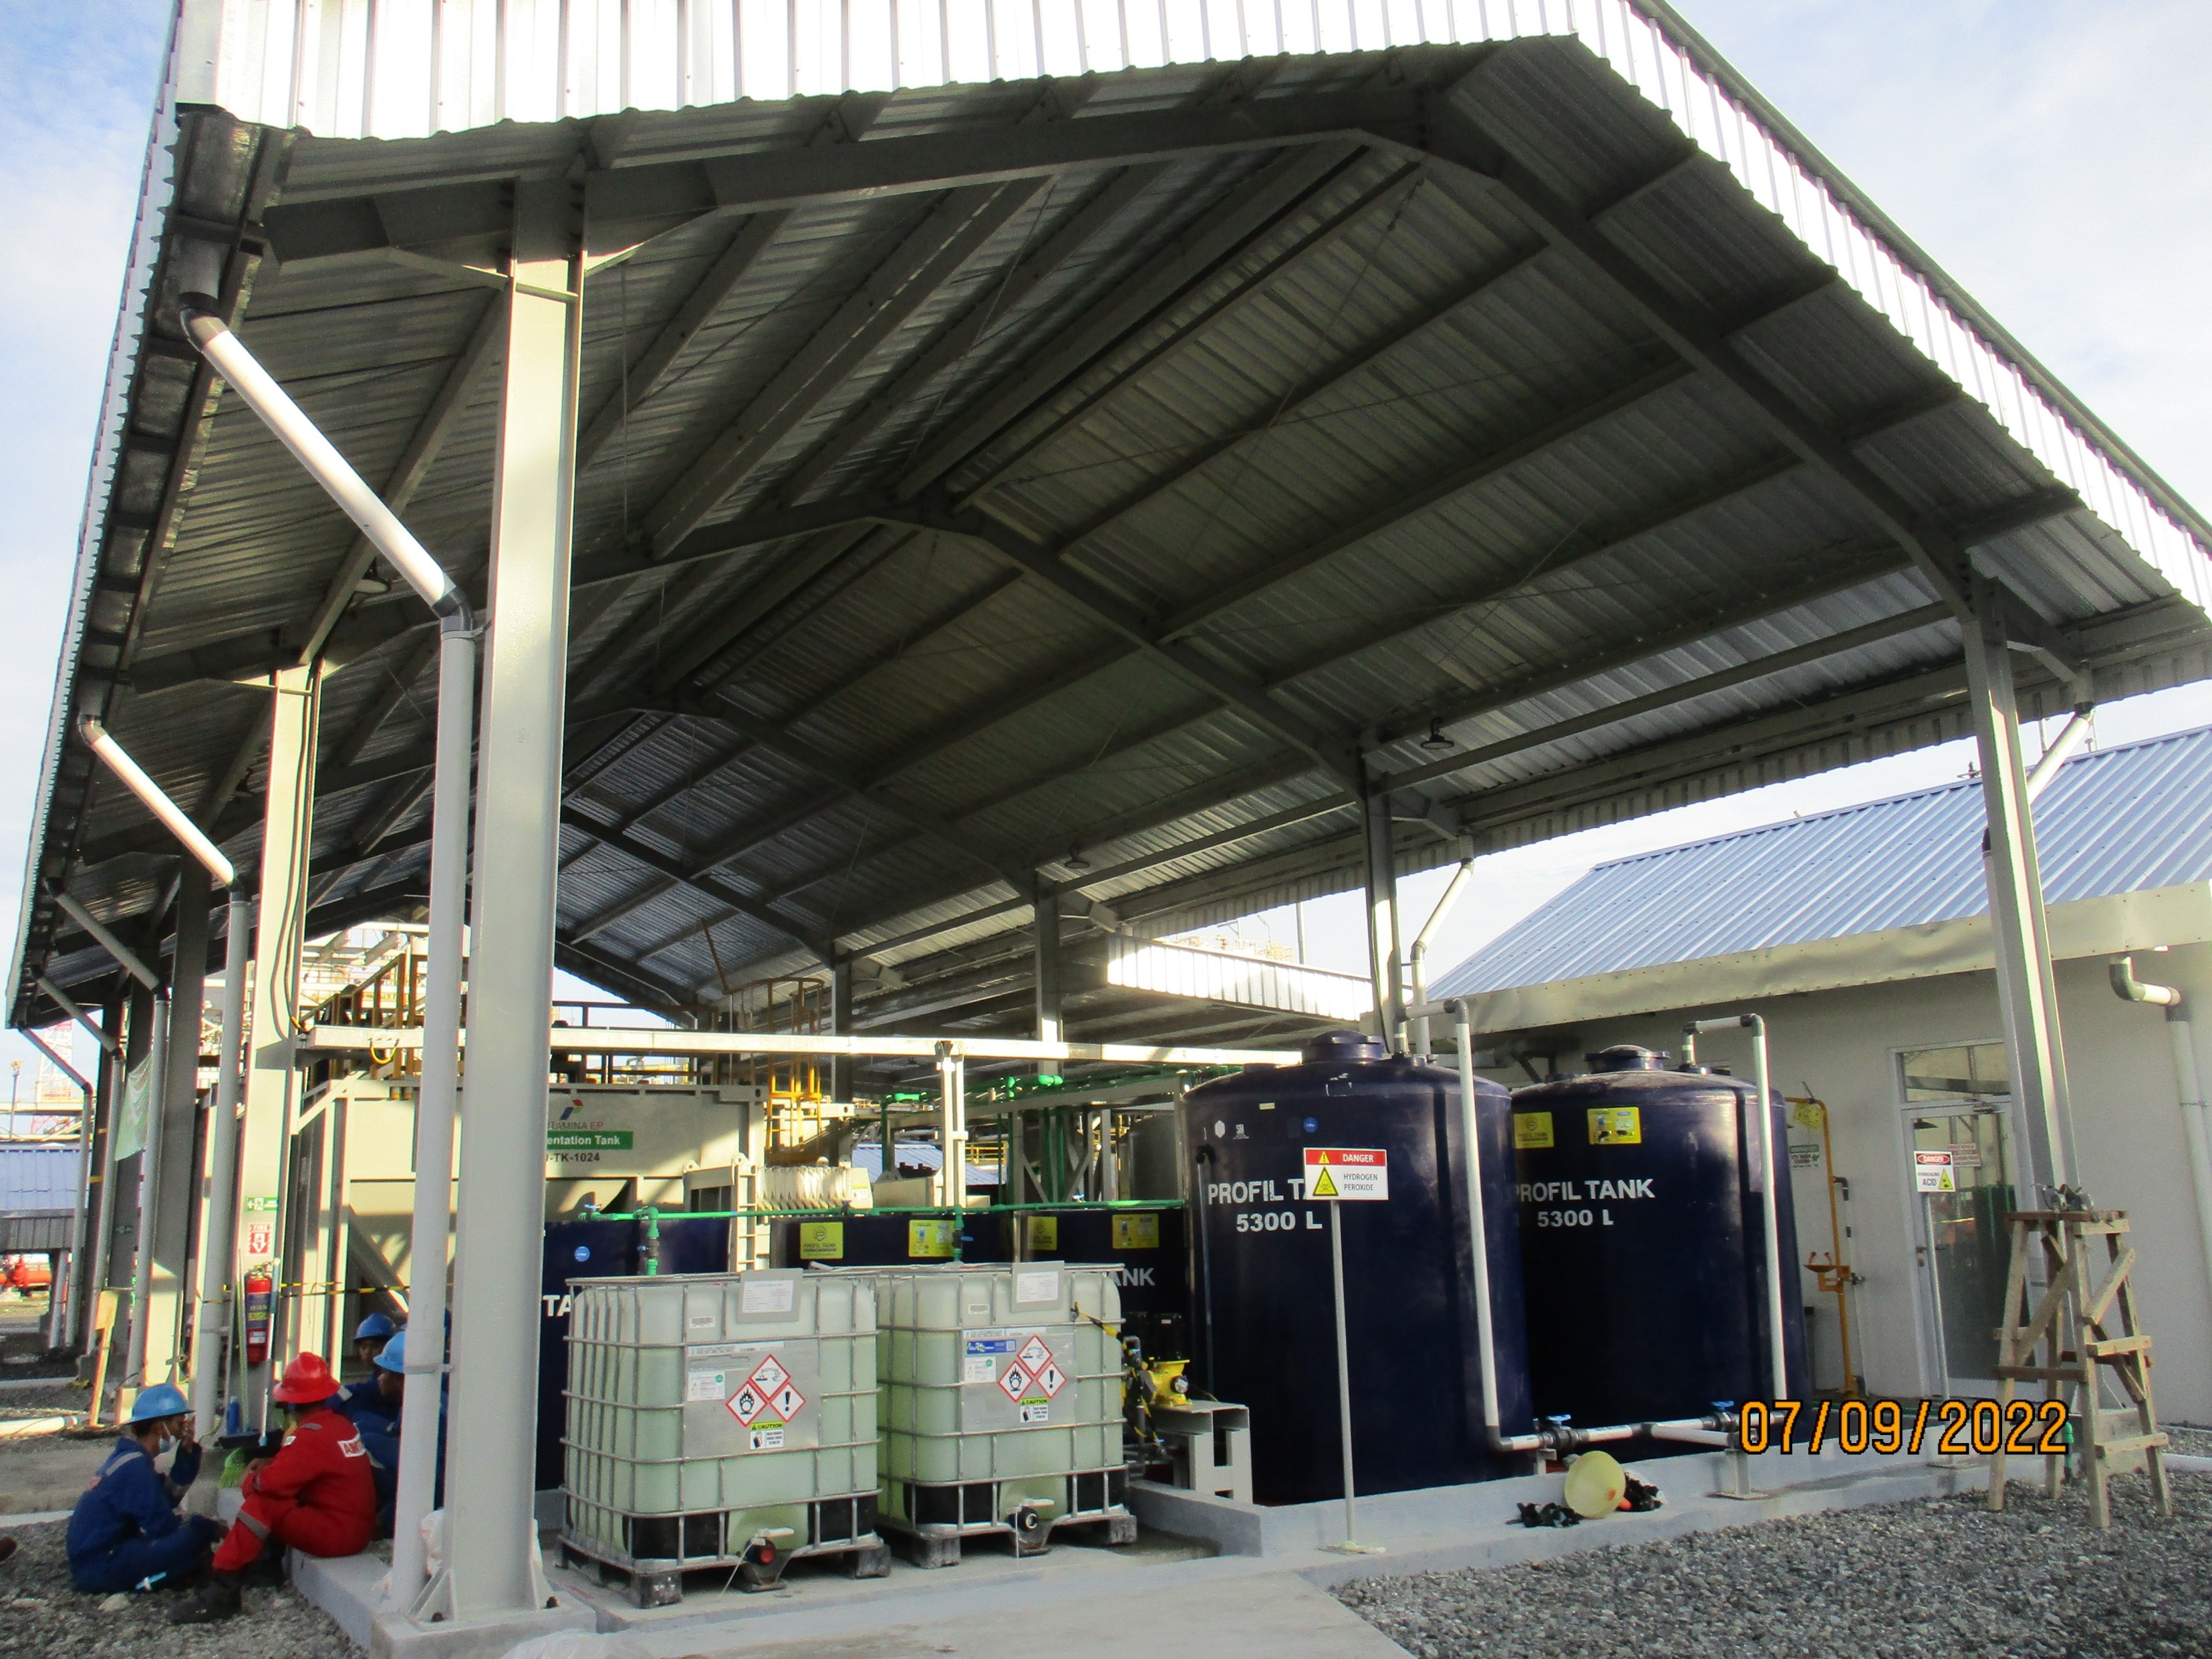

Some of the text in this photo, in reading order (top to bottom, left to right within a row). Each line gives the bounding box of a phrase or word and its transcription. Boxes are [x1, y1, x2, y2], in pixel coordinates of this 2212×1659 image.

[549, 1121, 603, 1130] TAMINA EP
[547, 1135, 621, 1145] entation Tank
[1343, 1153, 1375, 1164] DANGER
[1343, 1172, 1379, 1181] HYDROGEN
[1208, 1178, 1306, 1204] PROFIL T
[1344, 1183, 1374, 1191] PEROXIDE
[1584, 1178, 1656, 1200] TANK
[1236, 1210, 1323, 1233] 5300 L
[1538, 1208, 1614, 1227] 5300 L
[543, 1294, 571, 1317] TA
